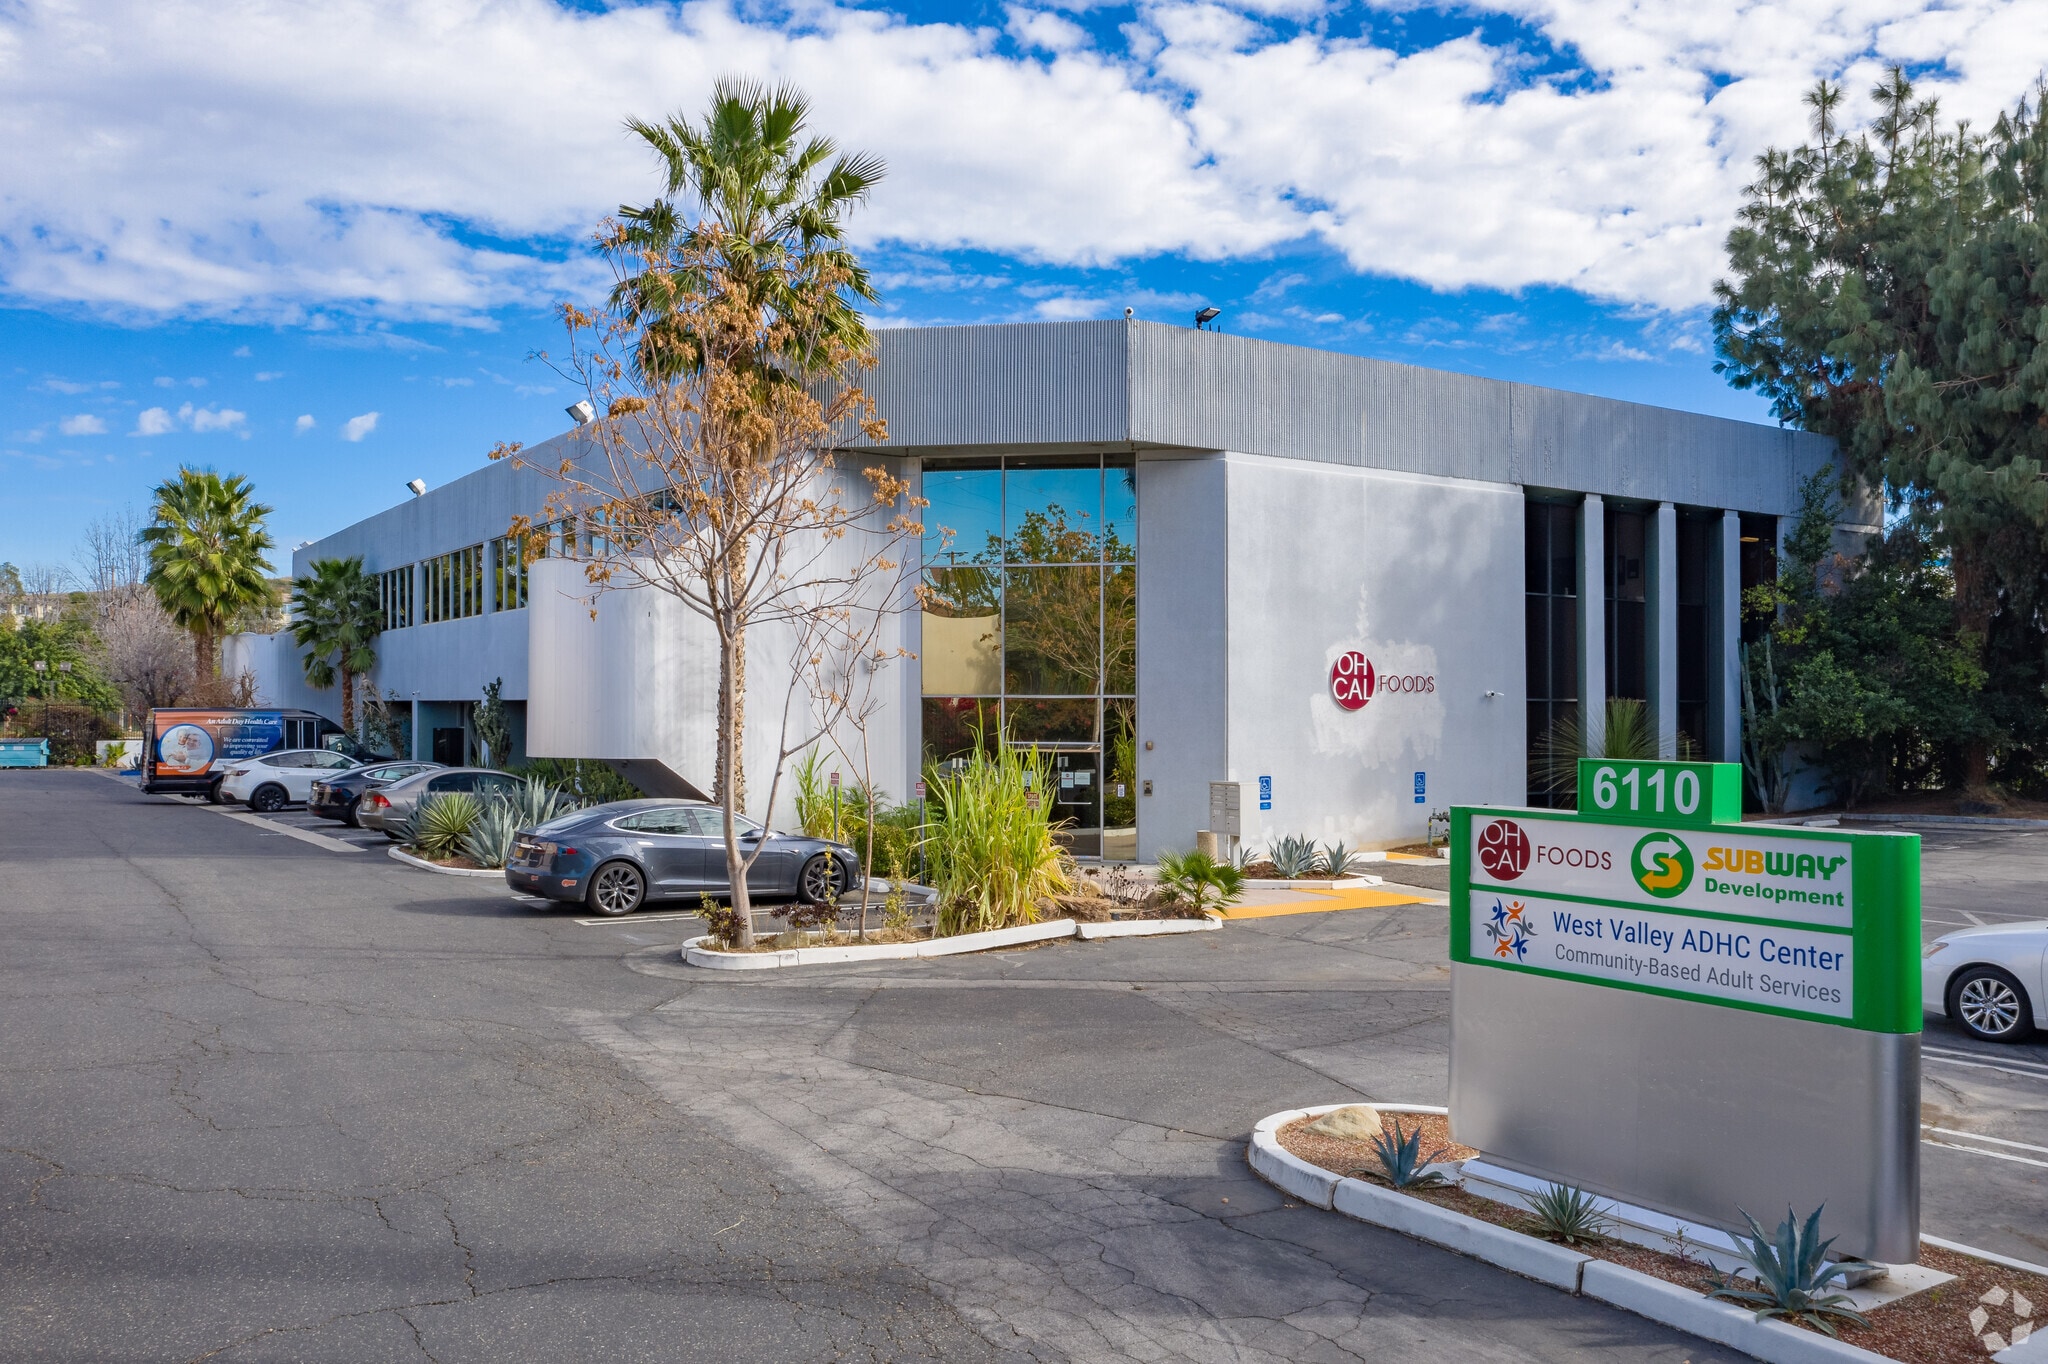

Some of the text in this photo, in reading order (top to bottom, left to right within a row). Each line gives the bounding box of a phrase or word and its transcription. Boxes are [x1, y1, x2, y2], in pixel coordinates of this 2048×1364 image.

[1338, 653, 1367, 676] OH
[1333, 677, 1372, 700] CAL
[1379, 675, 1435, 693] FOODS
[232, 718, 244, 726] Day
[1593, 766, 1700, 815] 6110
[1484, 822, 1521, 846] OH
[1479, 847, 1526, 873] CAL
[1537, 845, 1612, 871] FOODS
[1701, 847, 1848, 881] SUBWAY
[1705, 877, 1845, 907] Development
[1553, 911, 1844, 971] West Valley ADHC Center
[1555, 943, 1841, 1003] Community-Based Adult Services
